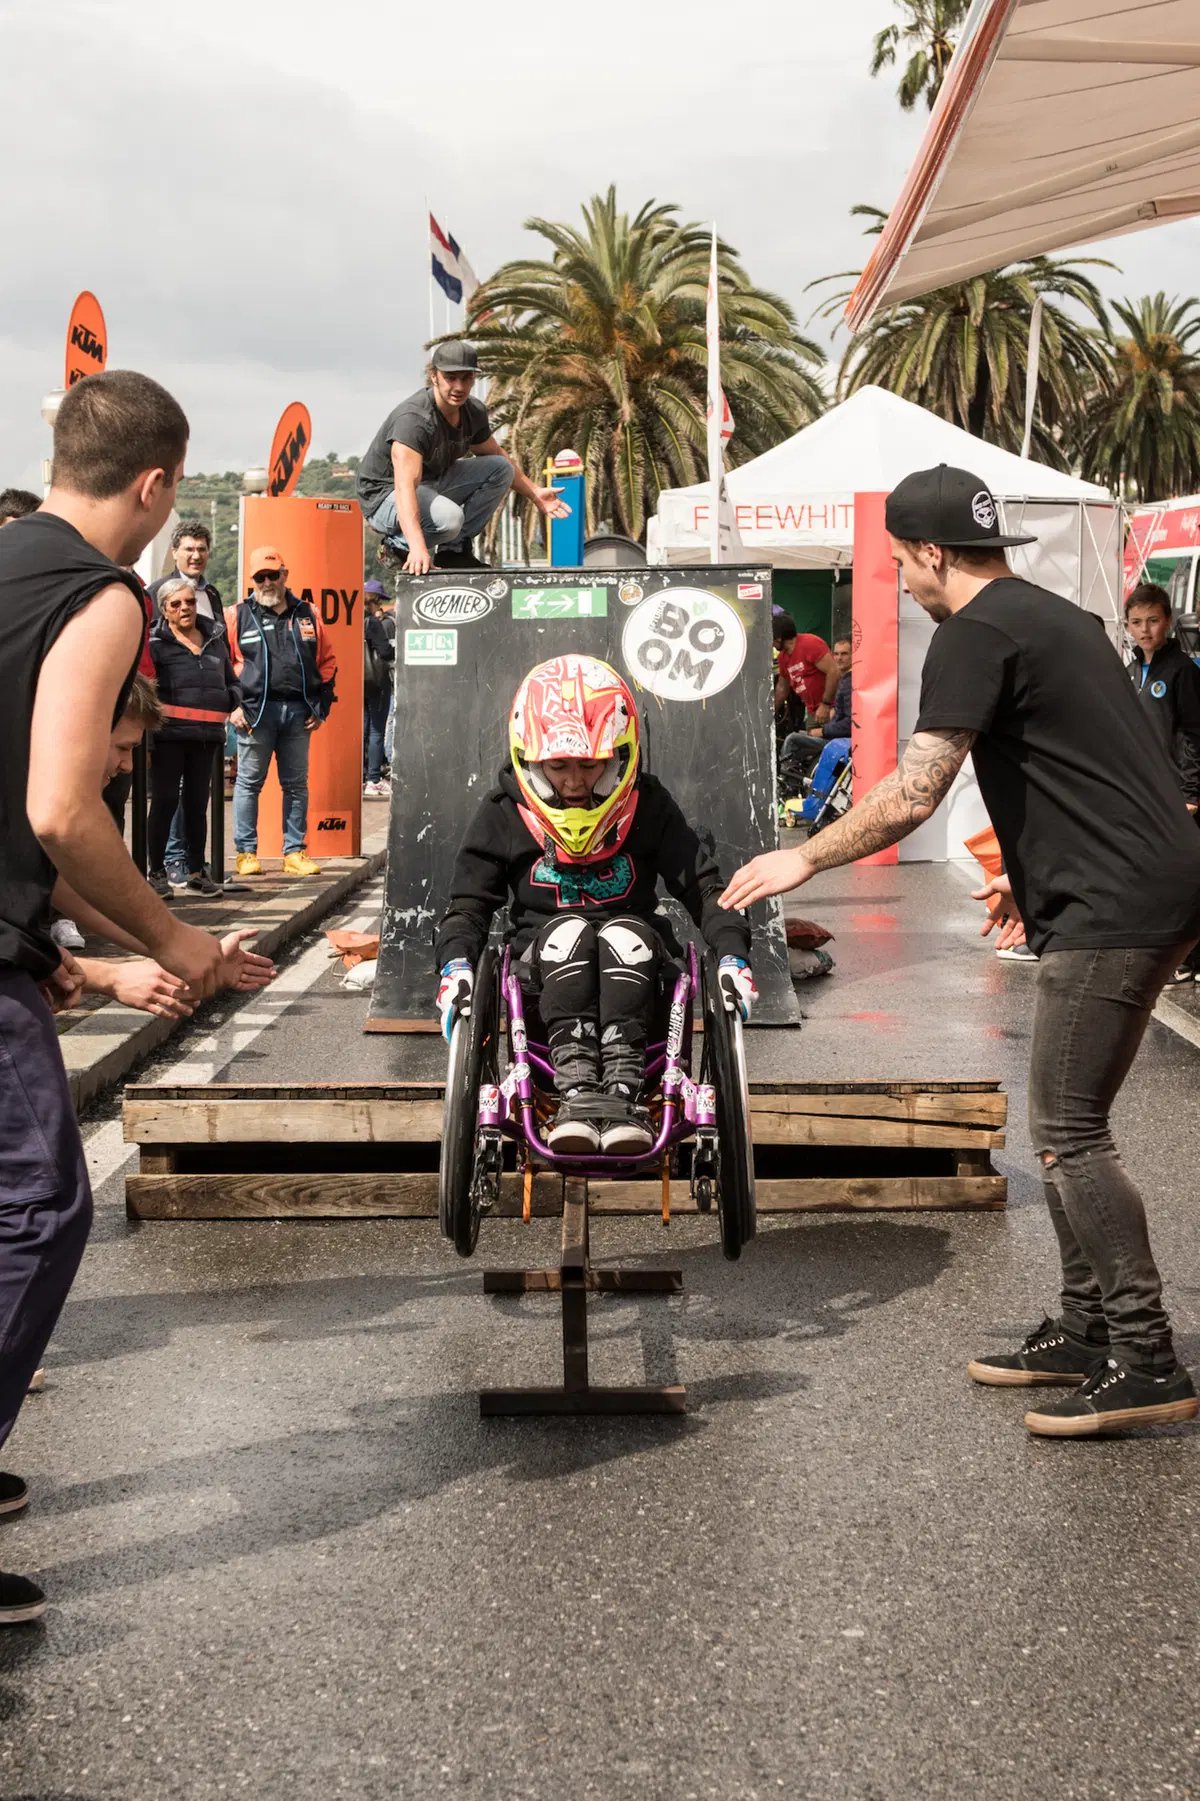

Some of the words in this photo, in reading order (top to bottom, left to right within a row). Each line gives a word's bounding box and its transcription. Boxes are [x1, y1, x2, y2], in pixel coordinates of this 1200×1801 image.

[71, 323, 103, 364] KTM
[271, 421, 307, 497] KTM
[693, 504, 855, 530] FEEWHIT
[424, 594, 488, 617] PREMIER
[317, 817, 347, 831] KTM
